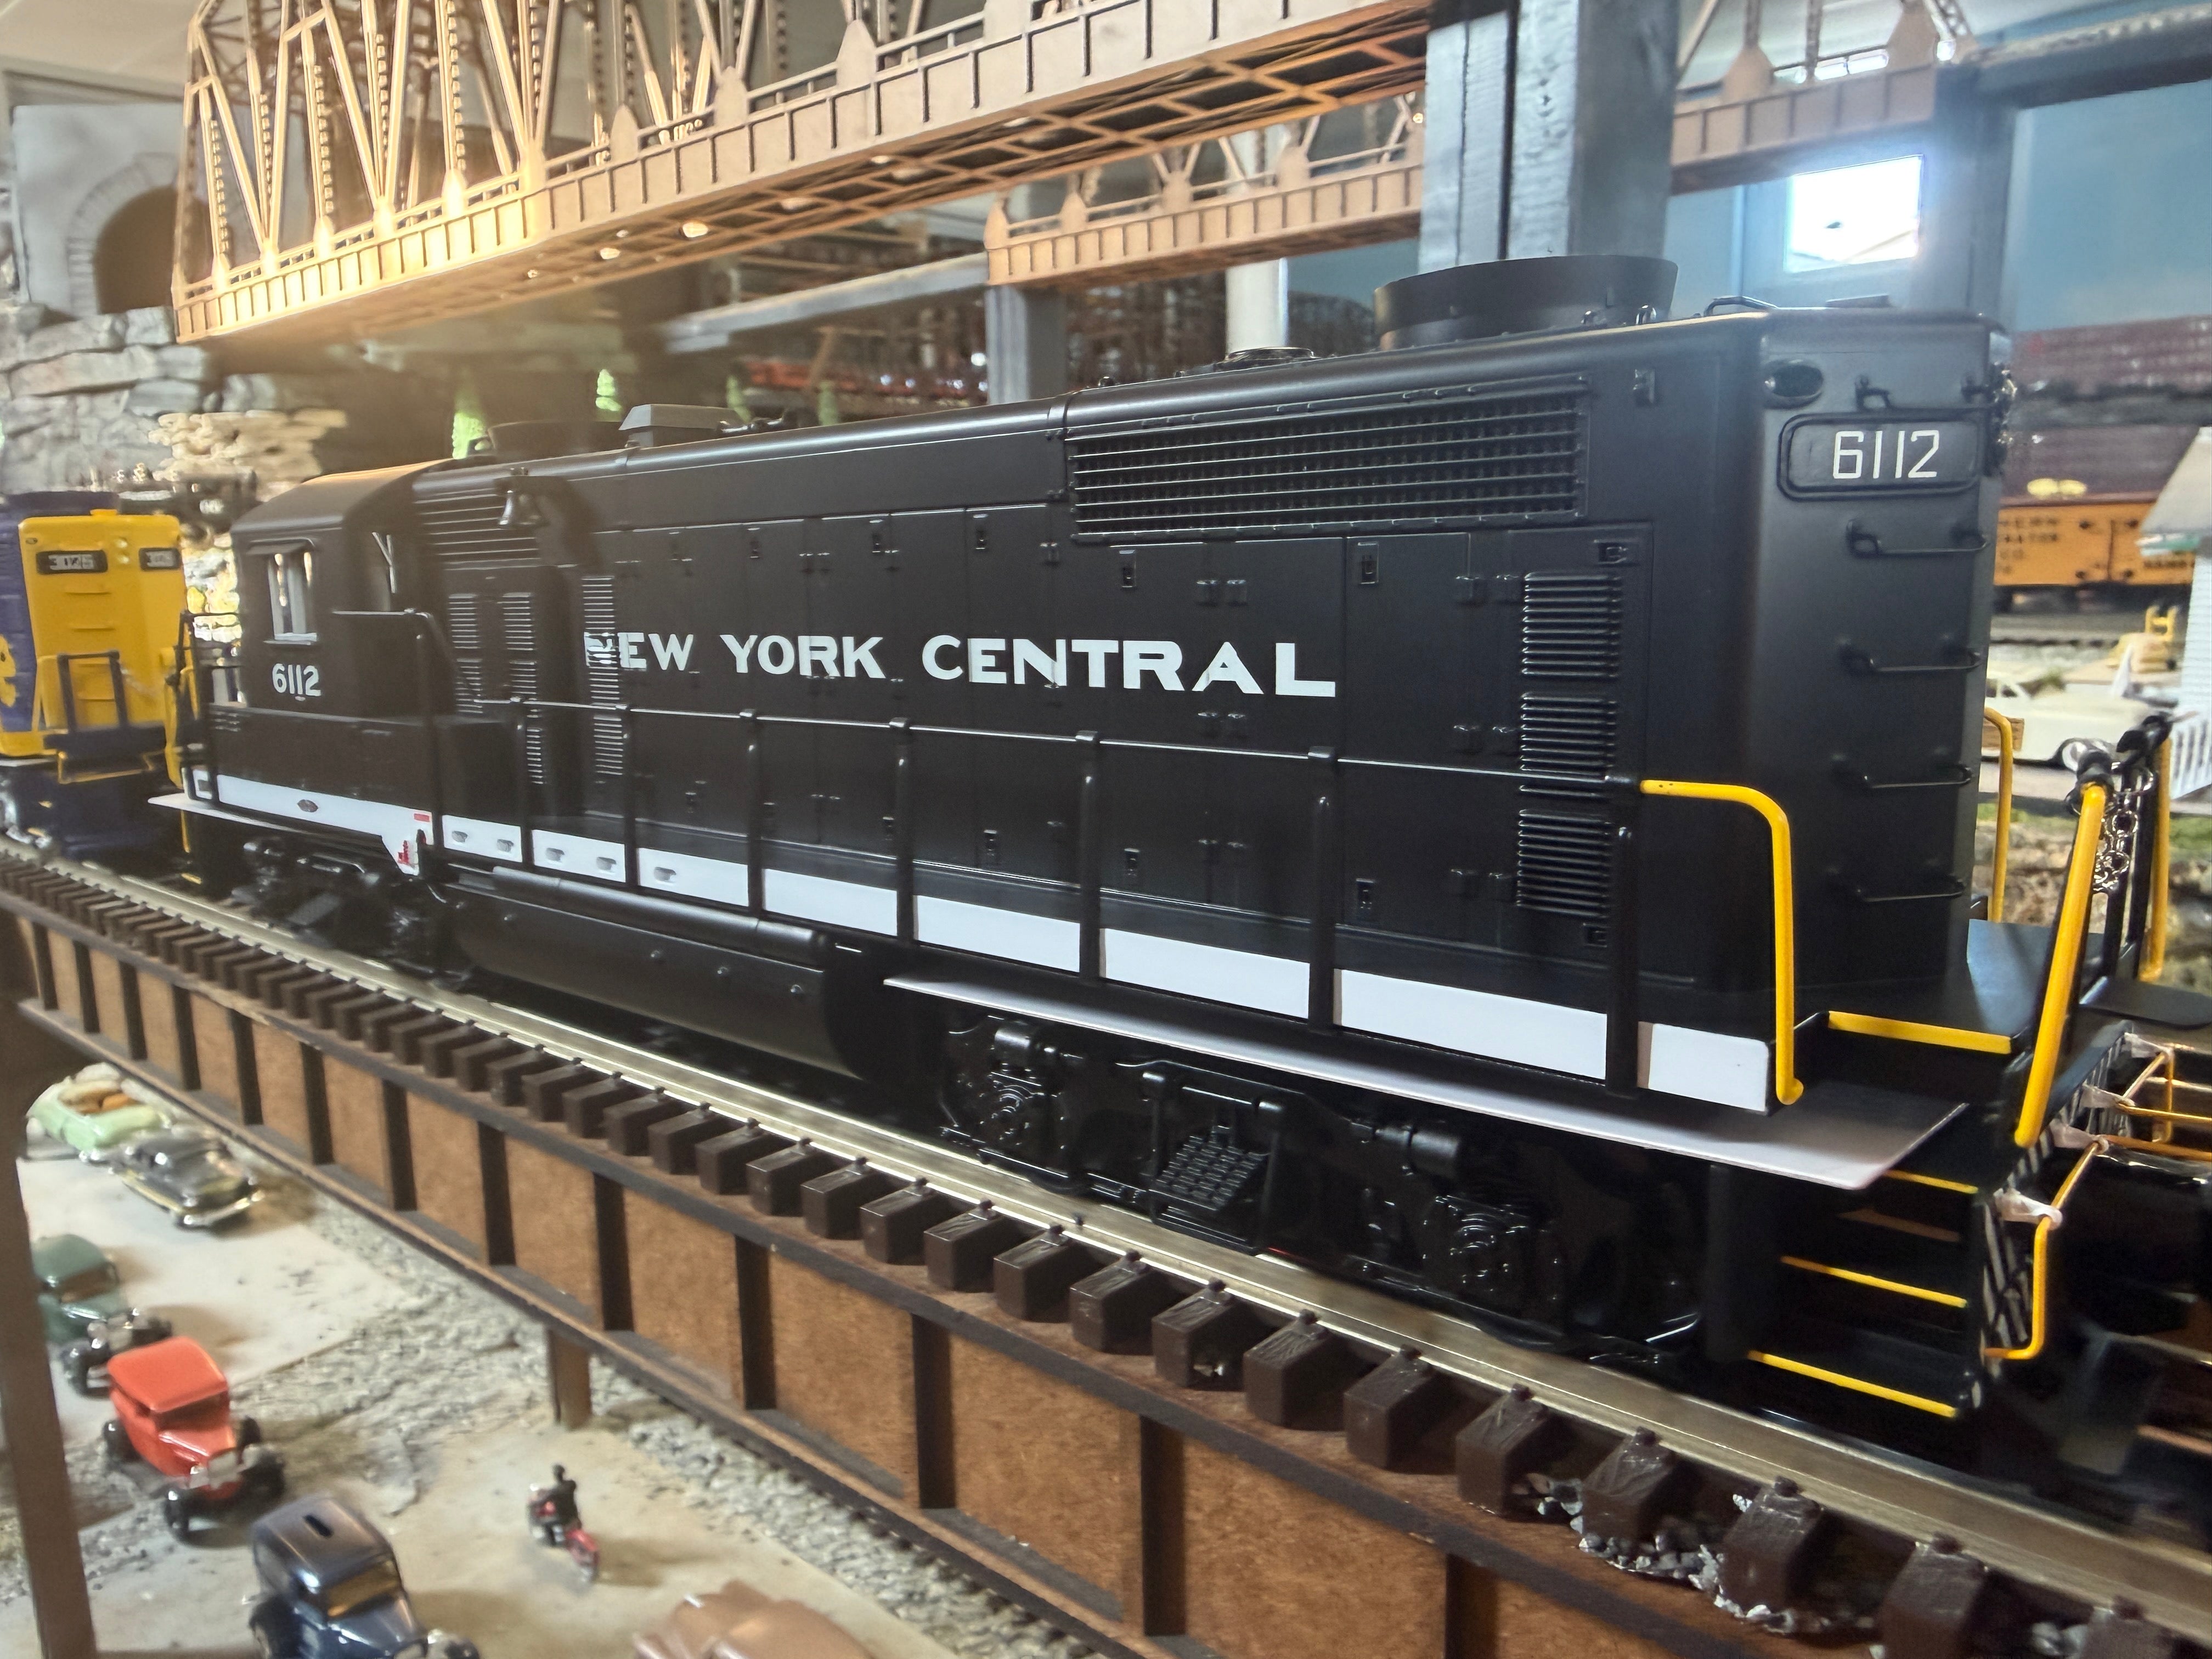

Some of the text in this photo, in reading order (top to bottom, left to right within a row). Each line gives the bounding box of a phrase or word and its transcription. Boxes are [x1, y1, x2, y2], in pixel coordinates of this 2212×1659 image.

[1832, 430, 1940, 479] 6112
[272, 663, 321, 697] 6112
[719, 634, 886, 679] YORK
[922, 635, 1336, 698] CENTRAL
